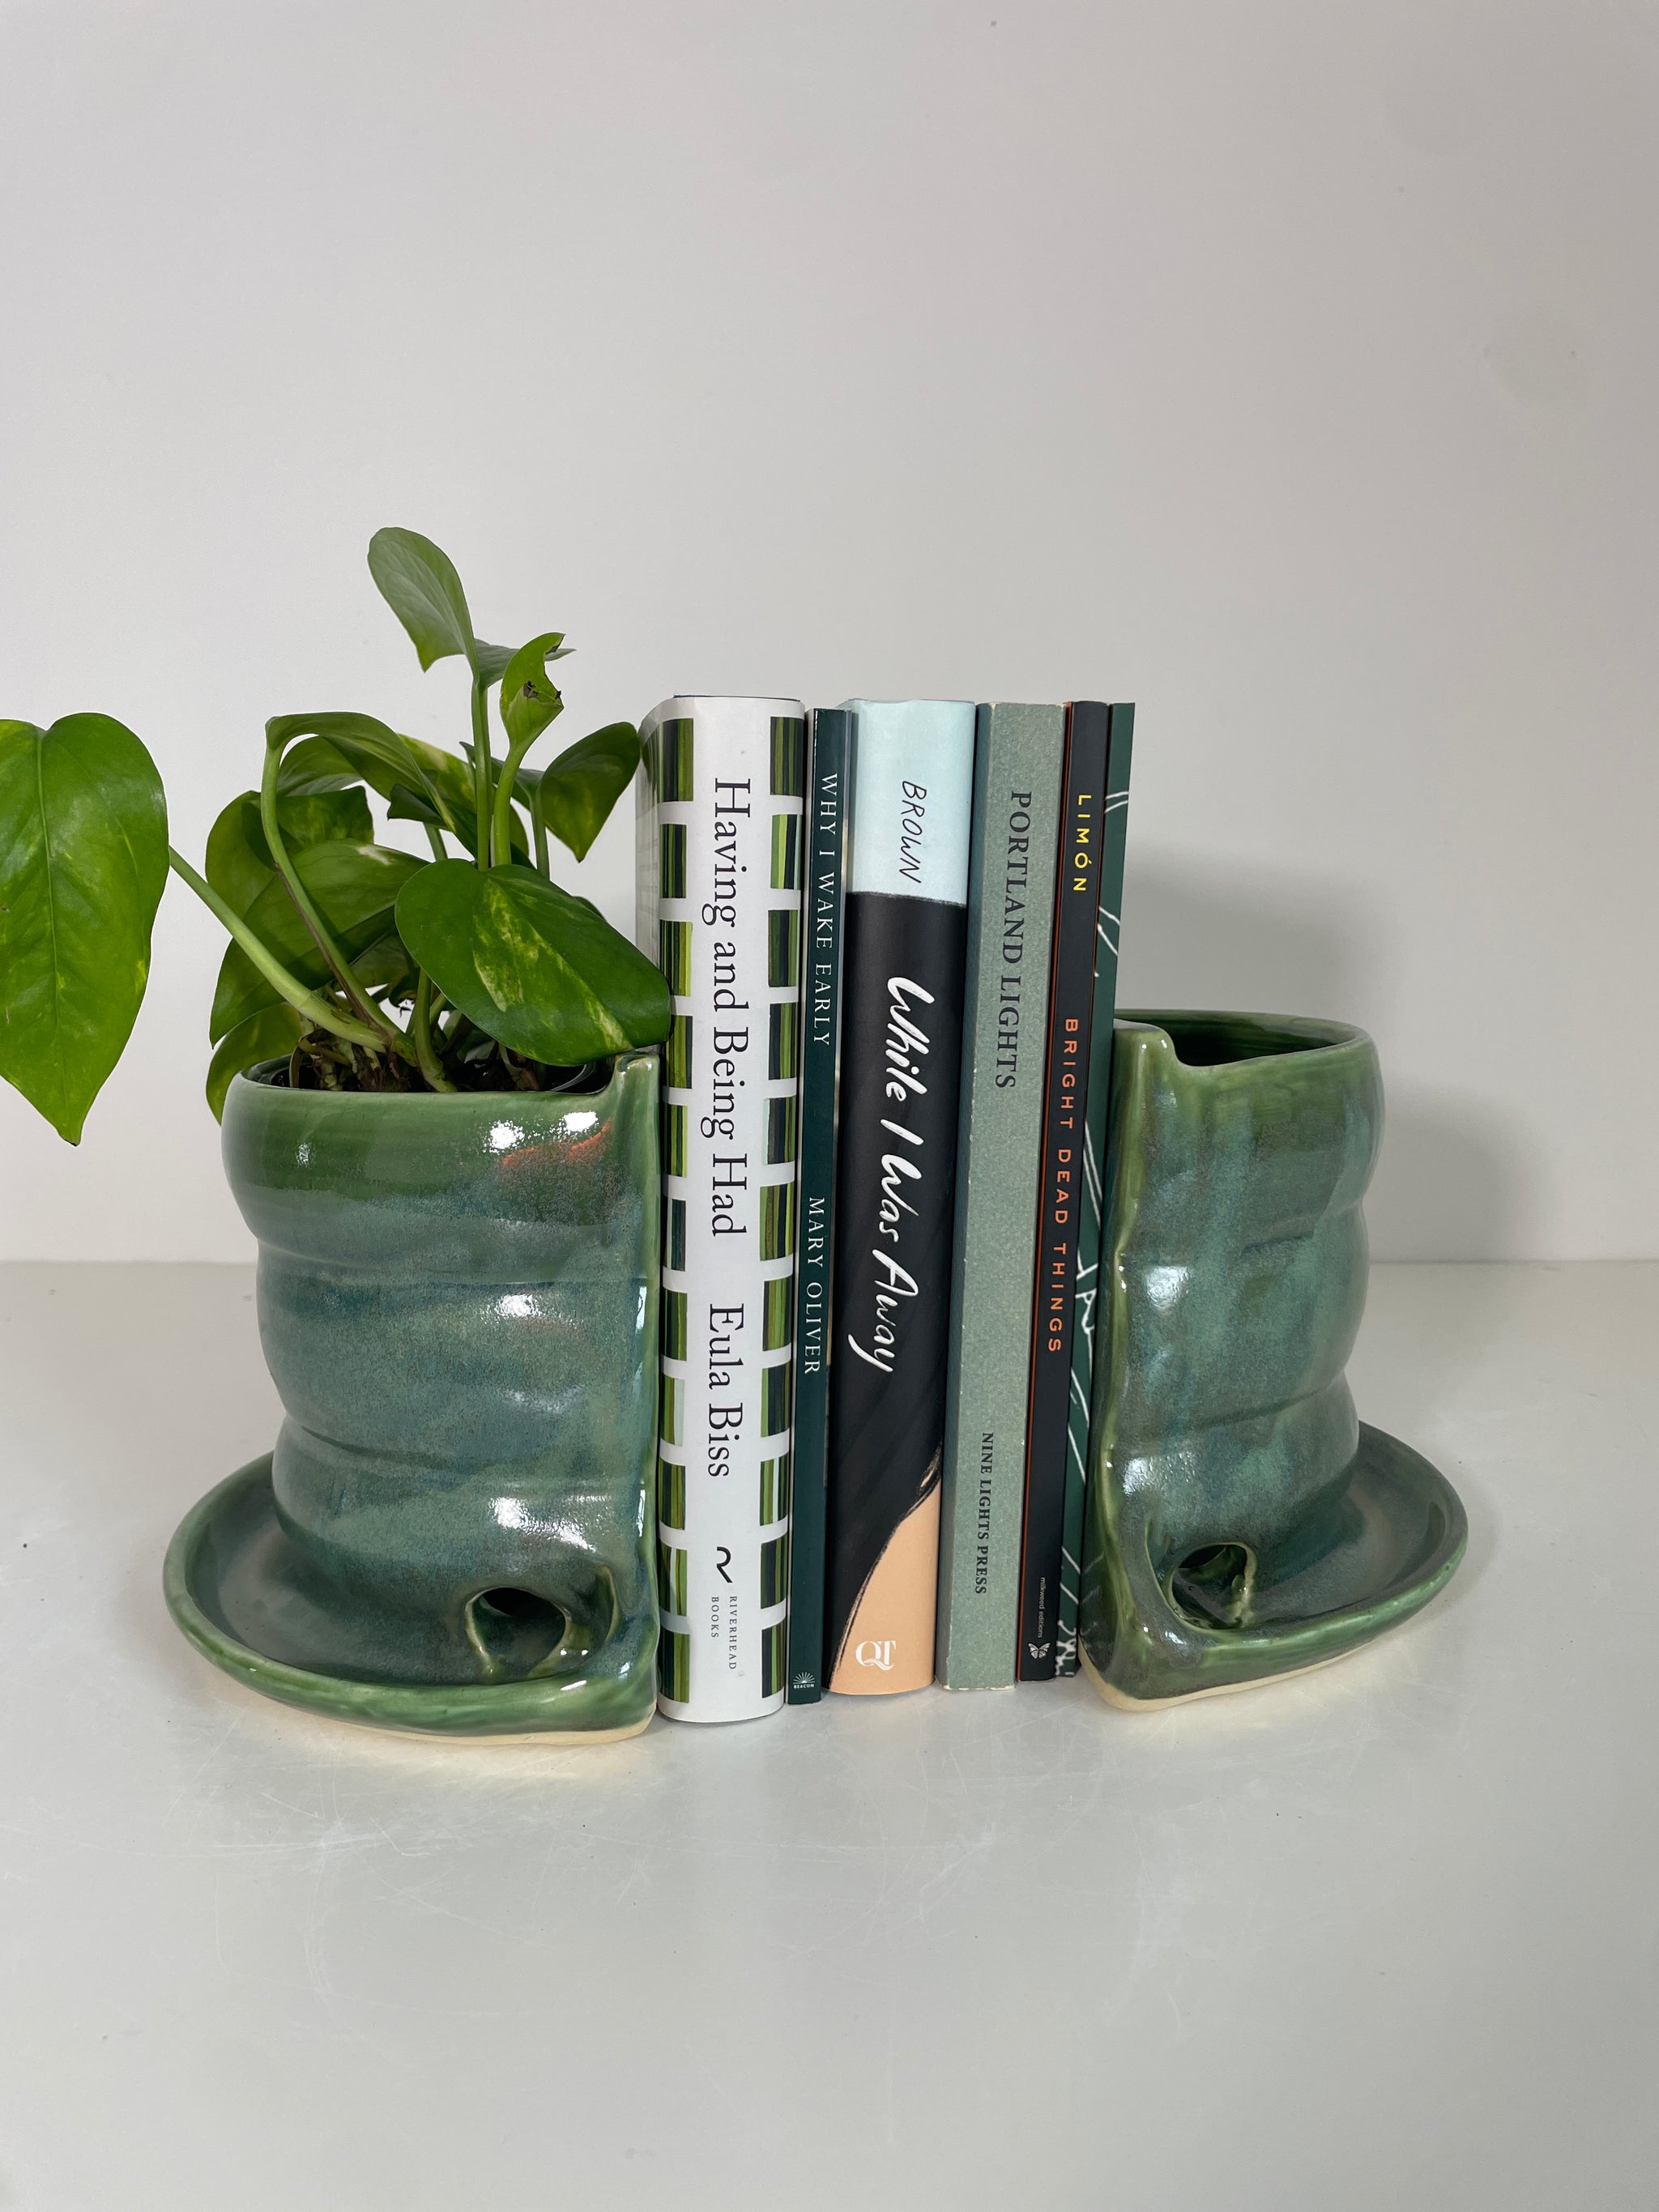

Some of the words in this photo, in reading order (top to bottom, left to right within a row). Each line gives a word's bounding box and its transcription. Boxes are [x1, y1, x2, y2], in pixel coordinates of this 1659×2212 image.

[820, 773, 838, 835] WHY
[898, 780, 928, 884] BROWN
[1073, 794, 1093, 892] LIMÓN
[702, 778, 751, 928] Having
[1002, 790, 1032, 964] PORTLAND
[816, 872, 834, 948] WAKE
[713, 942, 749, 1012] and
[813, 963, 832, 1046] EARLY
[885, 977, 935, 1102] While
[995, 974, 1021, 1089] LIGHTS
[700, 1026, 748, 1140] Being
[1060, 1018, 1079, 1128] BRIGHT
[880, 1119, 924, 1145] I
[711, 1153, 748, 1237] Had
[879, 1153, 922, 1242] Was
[1055, 1149, 1072, 1224] DEAD
[808, 1197, 825, 1268] MARY
[804, 1282, 822, 1375] OLIVER
[847, 1249, 919, 1372] Away
[1047, 1242, 1067, 1352] THINGS
[708, 1302, 744, 1390] Eula
[707, 1402, 744, 1477] Biss
[980, 1432, 994, 1474] NINE
[977, 1479, 992, 1540] LIGHTS
[975, 1545, 989, 1594] PRESS
[1038, 1576, 1047, 1609] milkweed
[710, 1596, 719, 1638] BOOKS
[728, 1596, 738, 1669] RIVERHEAD
[855, 1640, 897, 1671] QT
[1037, 1611, 1045, 1638] editions
